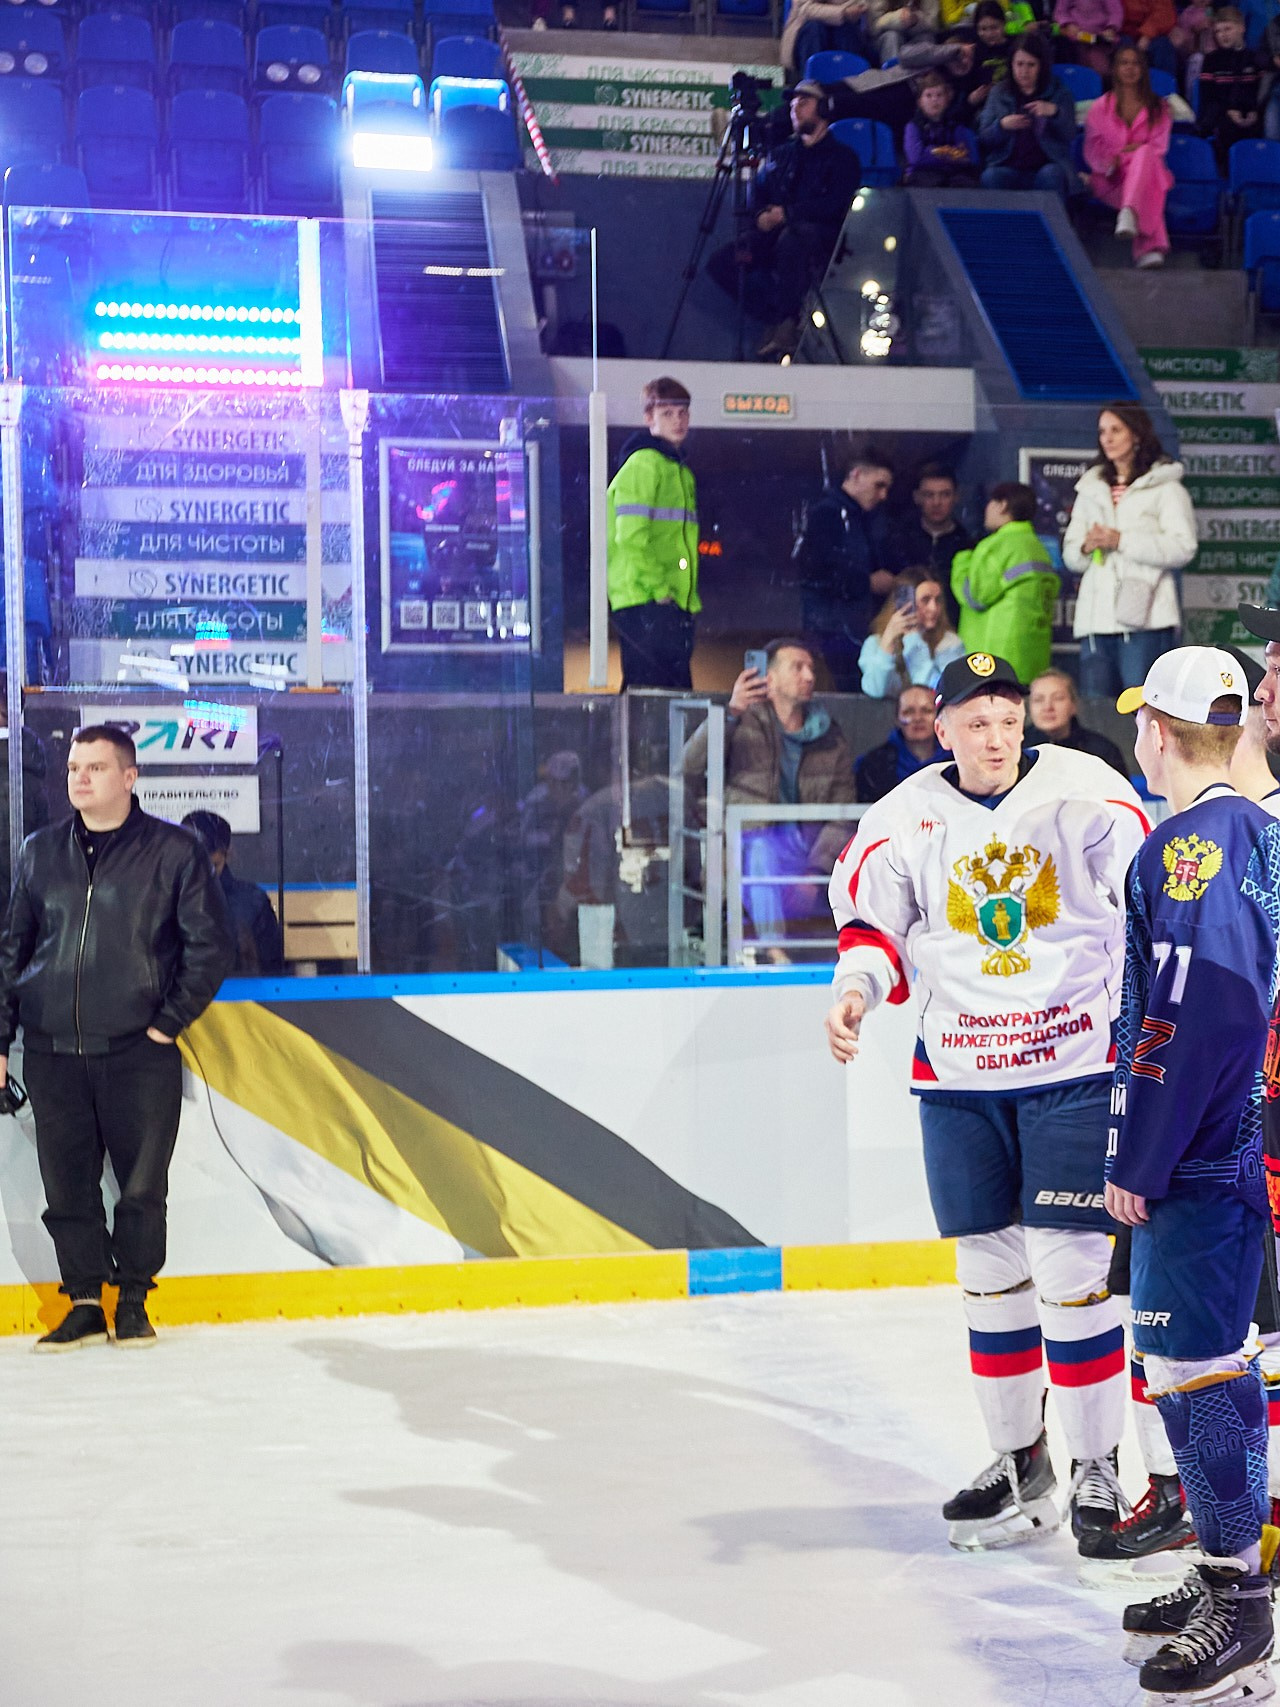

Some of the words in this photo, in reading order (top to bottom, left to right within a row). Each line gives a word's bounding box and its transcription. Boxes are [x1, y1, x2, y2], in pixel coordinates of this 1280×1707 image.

[621, 88, 715, 109] SYNERGETIC
[725, 395, 790, 414] ВЫХОД
[172, 429, 288, 450] SYNERGETIC
[136, 464, 177, 482] ДЛЯ
[183, 463, 289, 483] ЗДОРОВЬЯ
[407, 457, 455, 473] СЛЕДУЙ
[169, 500, 290, 523] SYNERGETIC
[139, 534, 182, 554] ДЛЯ
[187, 534, 285, 553] ЧИСТОТЫ
[165, 573, 289, 596] SYNERGETIC
[135, 611, 180, 632] ДЛЯ
[143, 788, 239, 800] ПРАВИТЕЛЬСТВО
[957, 1003, 1070, 1028] ПРОКУРАТУРА
[941, 1012, 1093, 1048] НИЖЕГОРОДСКОЙ
[976, 1046, 1056, 1070] ОБЛАСТИ
